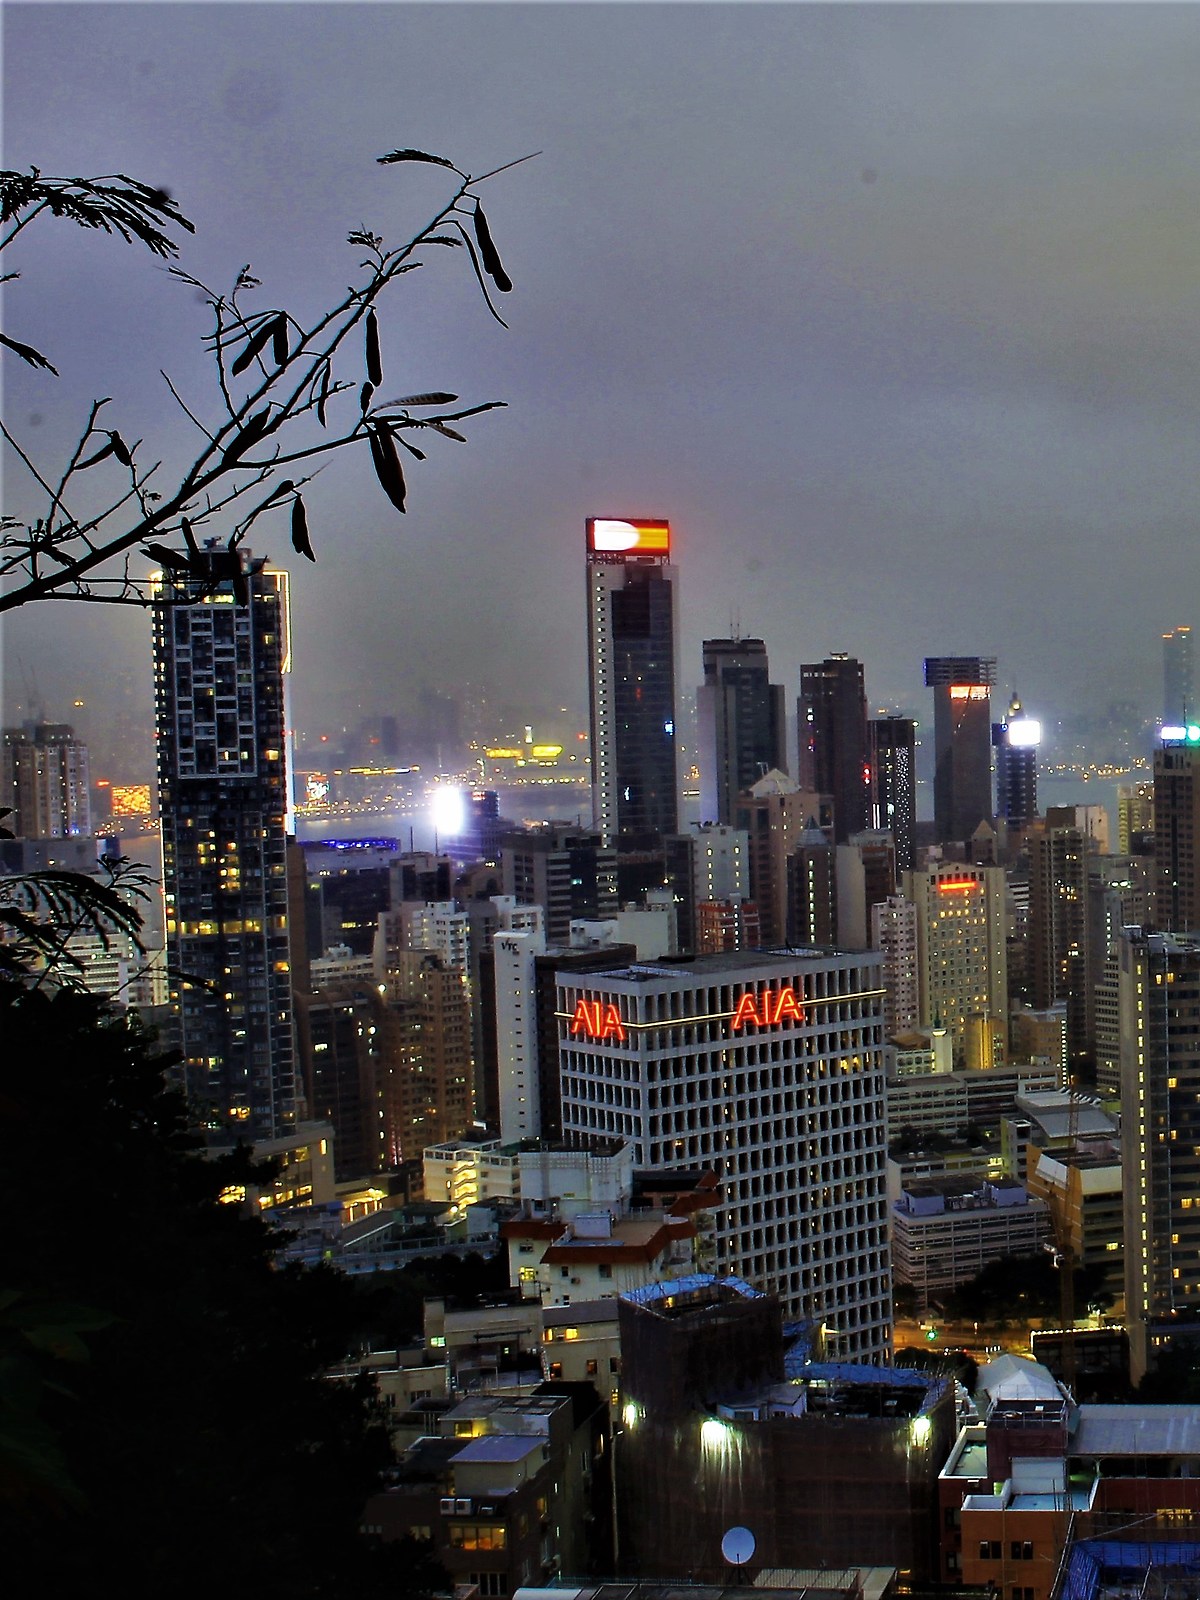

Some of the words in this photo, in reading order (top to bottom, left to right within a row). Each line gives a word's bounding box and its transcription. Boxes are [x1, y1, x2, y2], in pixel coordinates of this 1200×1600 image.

[501, 937, 518, 951] VTC
[571, 999, 625, 1041] AIA
[732, 987, 804, 1030] AIA
